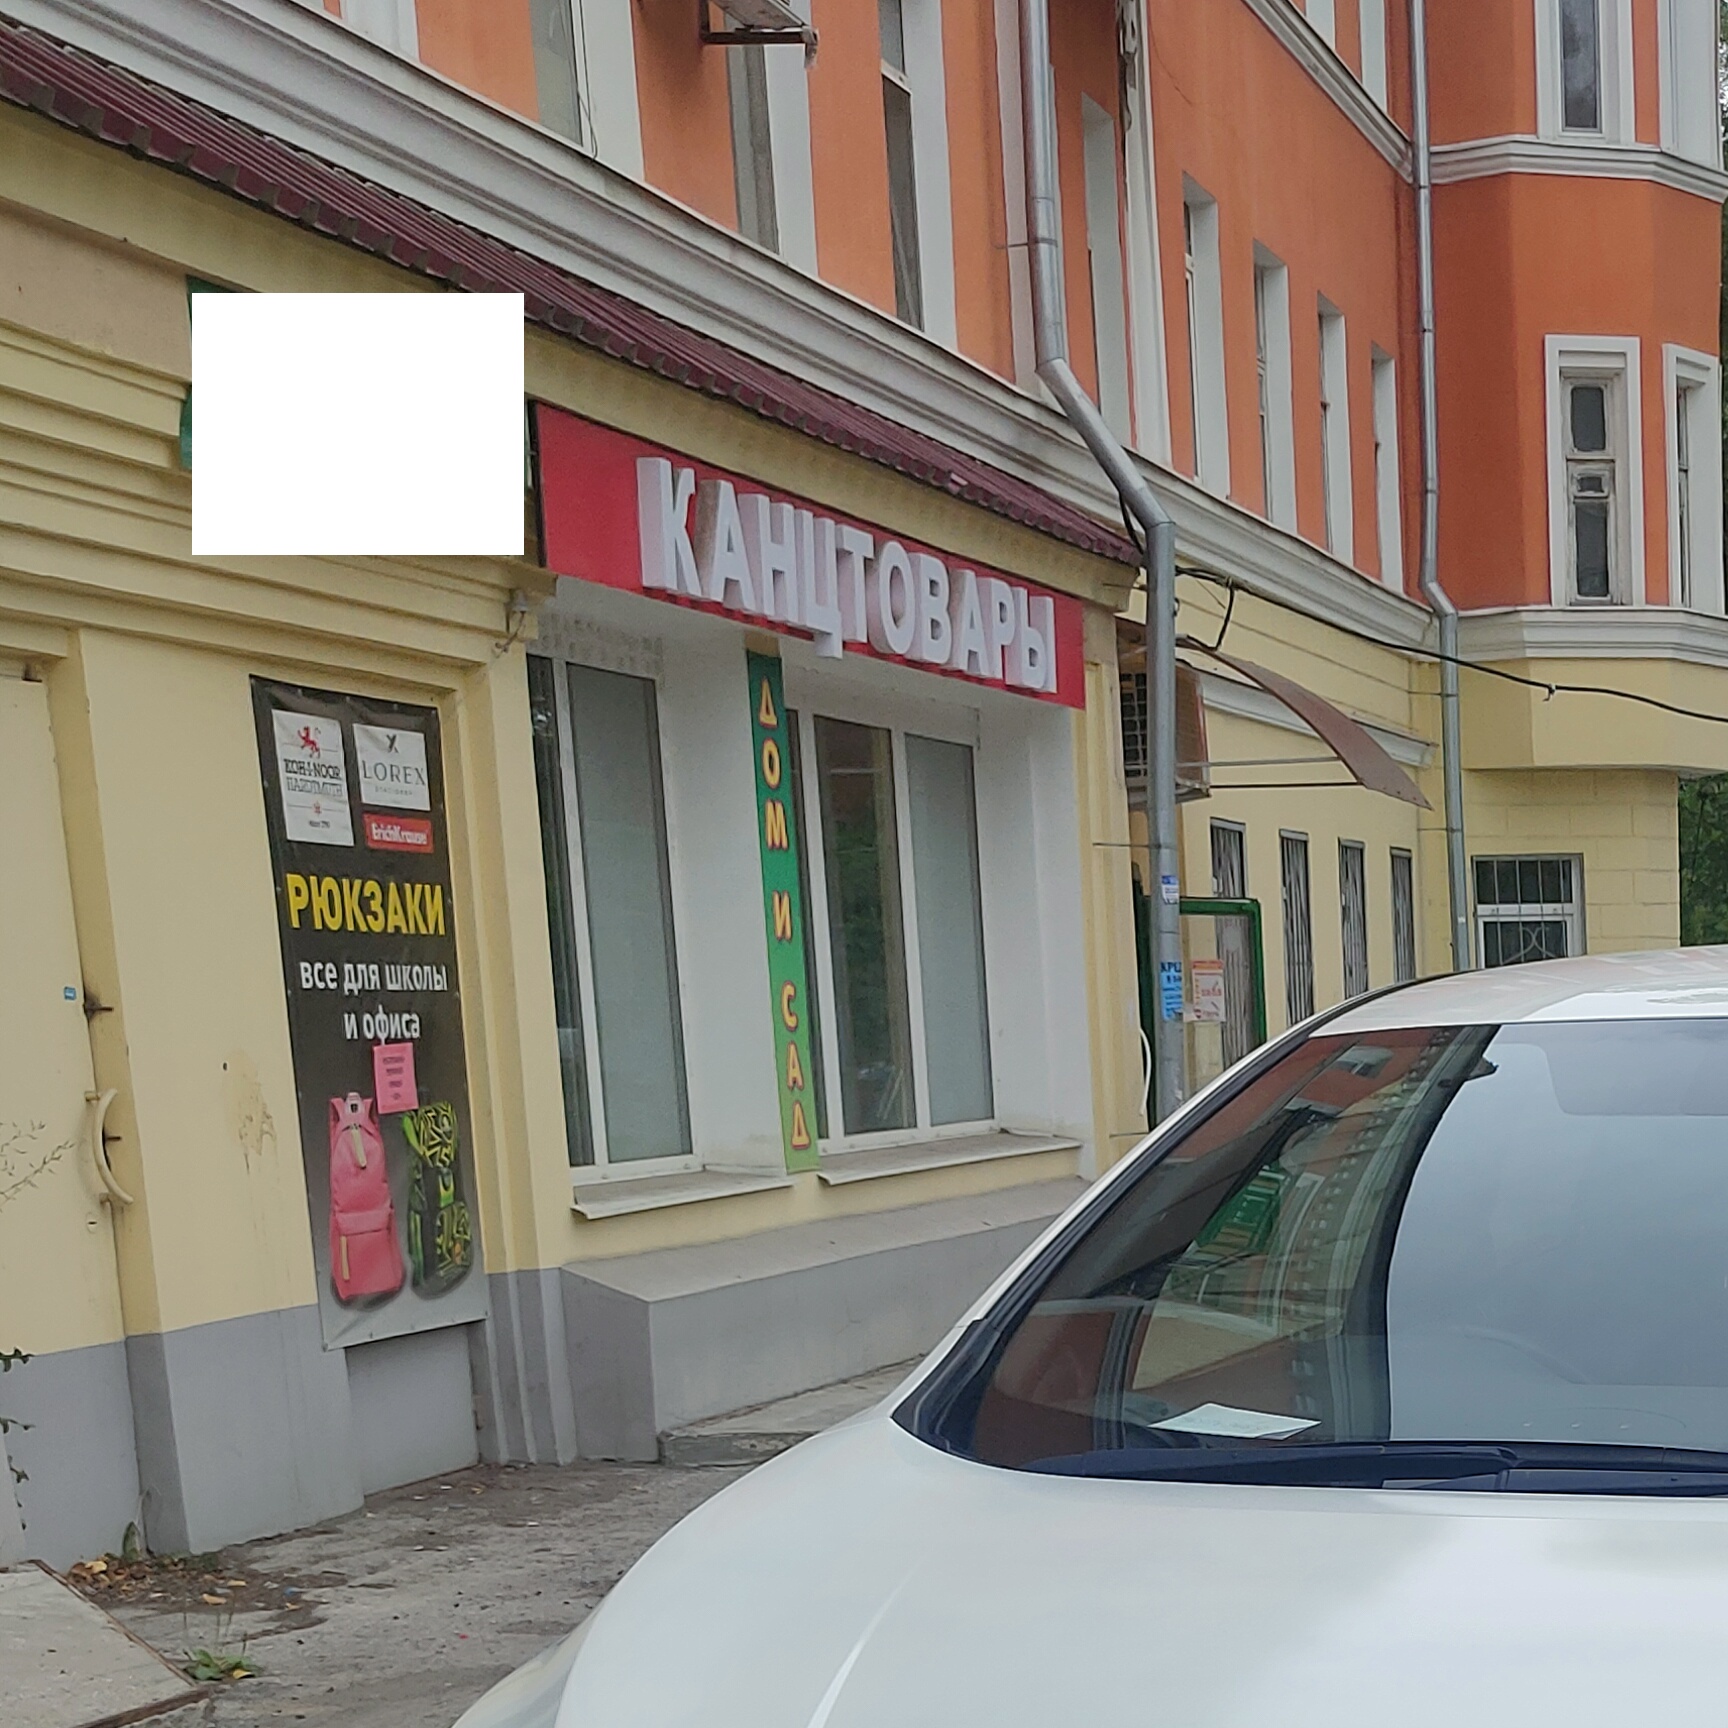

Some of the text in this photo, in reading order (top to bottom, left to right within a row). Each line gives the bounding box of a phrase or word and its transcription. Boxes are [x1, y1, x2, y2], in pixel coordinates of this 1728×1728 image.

[636, 457, 1057, 693] КАНЦТОВАРЫ
[362, 760, 426, 786] LOREX
[286, 873, 446, 935] РЮКЗАКИ
[759, 676, 810, 1149] ДОМ И САД
[300, 962, 448, 995] все для школы
[344, 1004, 421, 1046] и офиса
